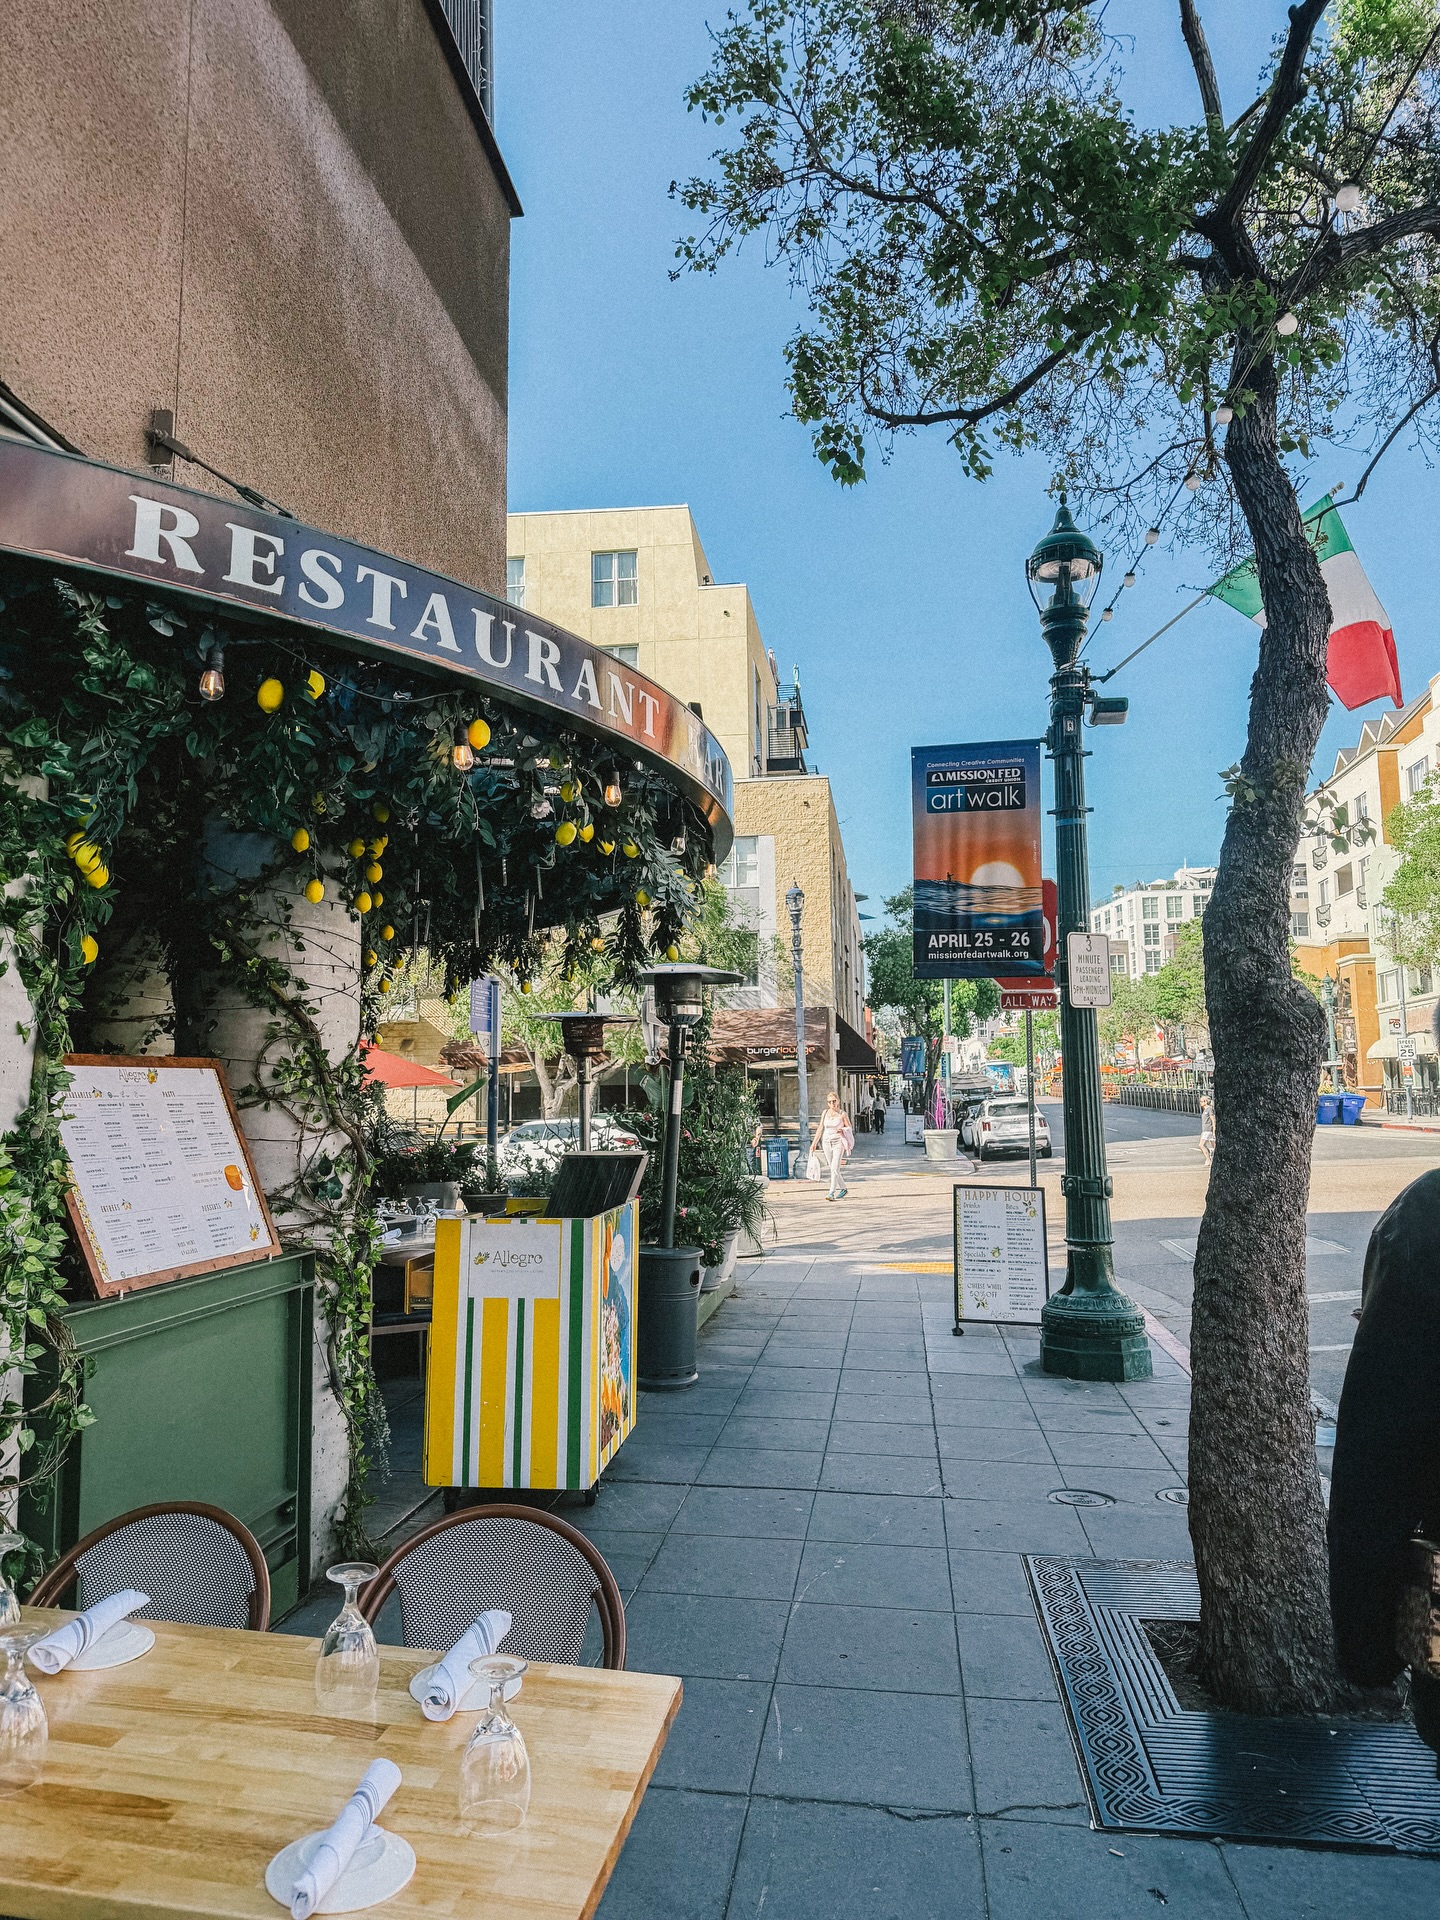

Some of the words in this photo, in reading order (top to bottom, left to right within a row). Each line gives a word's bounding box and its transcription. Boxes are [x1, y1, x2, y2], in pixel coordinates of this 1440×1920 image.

[125, 494, 661, 740] RESTAURANT
[945, 769, 995, 781] MISSION
[998, 768, 1021, 778] FED
[931, 788, 963, 810] art
[967, 786, 1021, 807] walk
[928, 934, 971, 948] APRIL
[974, 932, 993, 947] 25
[1011, 931, 1030, 946] 26
[1085, 939, 1092, 952] 3
[928, 950, 1029, 960] missionfedartwalk.org
[1077, 954, 1101, 964] MINUTE
[1075, 966, 1104, 975] PASSENGER
[1080, 975, 1101, 983] LOADING
[1004, 996, 1026, 1007] ALL
[1031, 996, 1053, 1006] WAY
[1400, 1049, 1415, 1058] 25
[119, 1068, 147, 1083] Allegro
[964, 1190, 998, 1201] HAPPY
[1004, 1192, 1037, 1202] HOUR
[492, 1250, 544, 1267] Allegro
